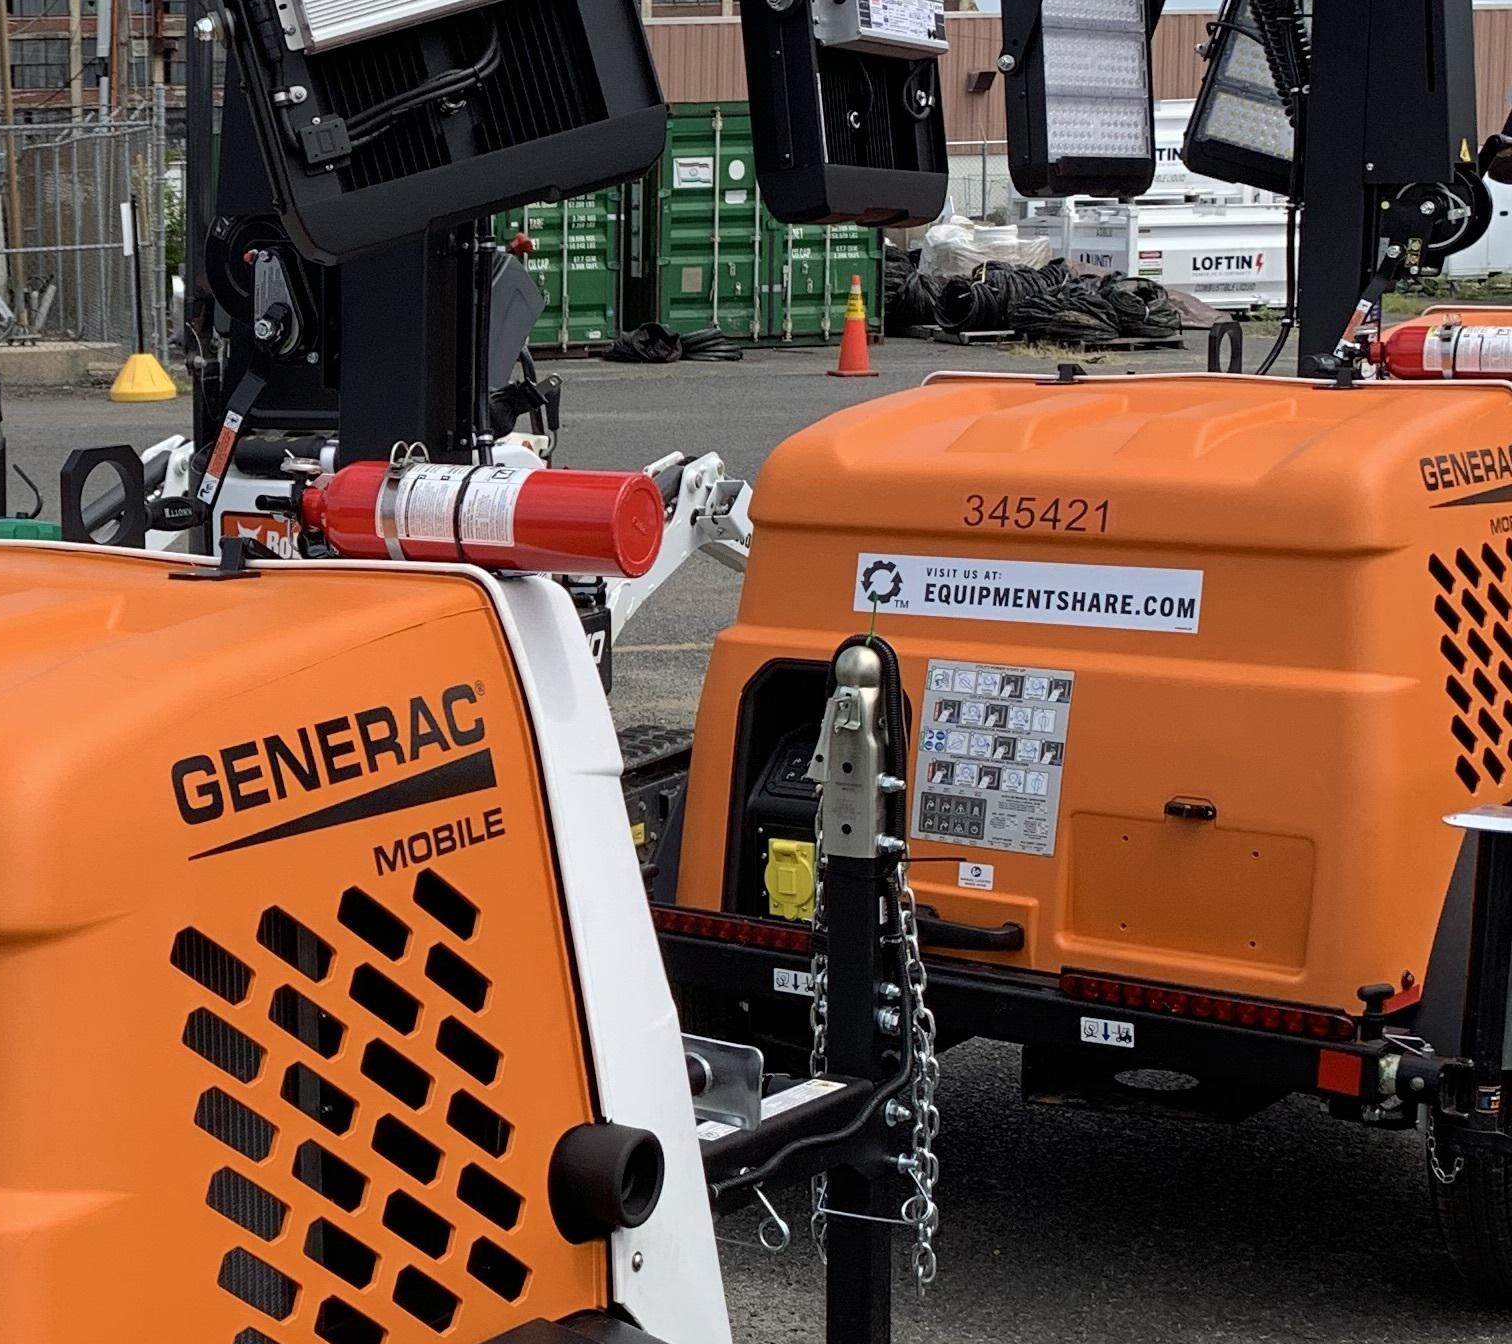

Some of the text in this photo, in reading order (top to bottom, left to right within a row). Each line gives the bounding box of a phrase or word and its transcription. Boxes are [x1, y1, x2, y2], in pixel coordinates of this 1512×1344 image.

[1155, 147, 1182, 161] TIN
[1192, 255, 1253, 271] LOFTIN
[1419, 445, 1512, 492] GENERA
[963, 494, 1110, 533] 345421
[926, 567, 1003, 581] VISIT US AT:
[894, 599, 910, 609] TM
[924, 582, 1196, 620] EQUIPMENTSHARE.COM
[171, 683, 486, 826] GENERAC
[372, 807, 506, 877] MOBILE
